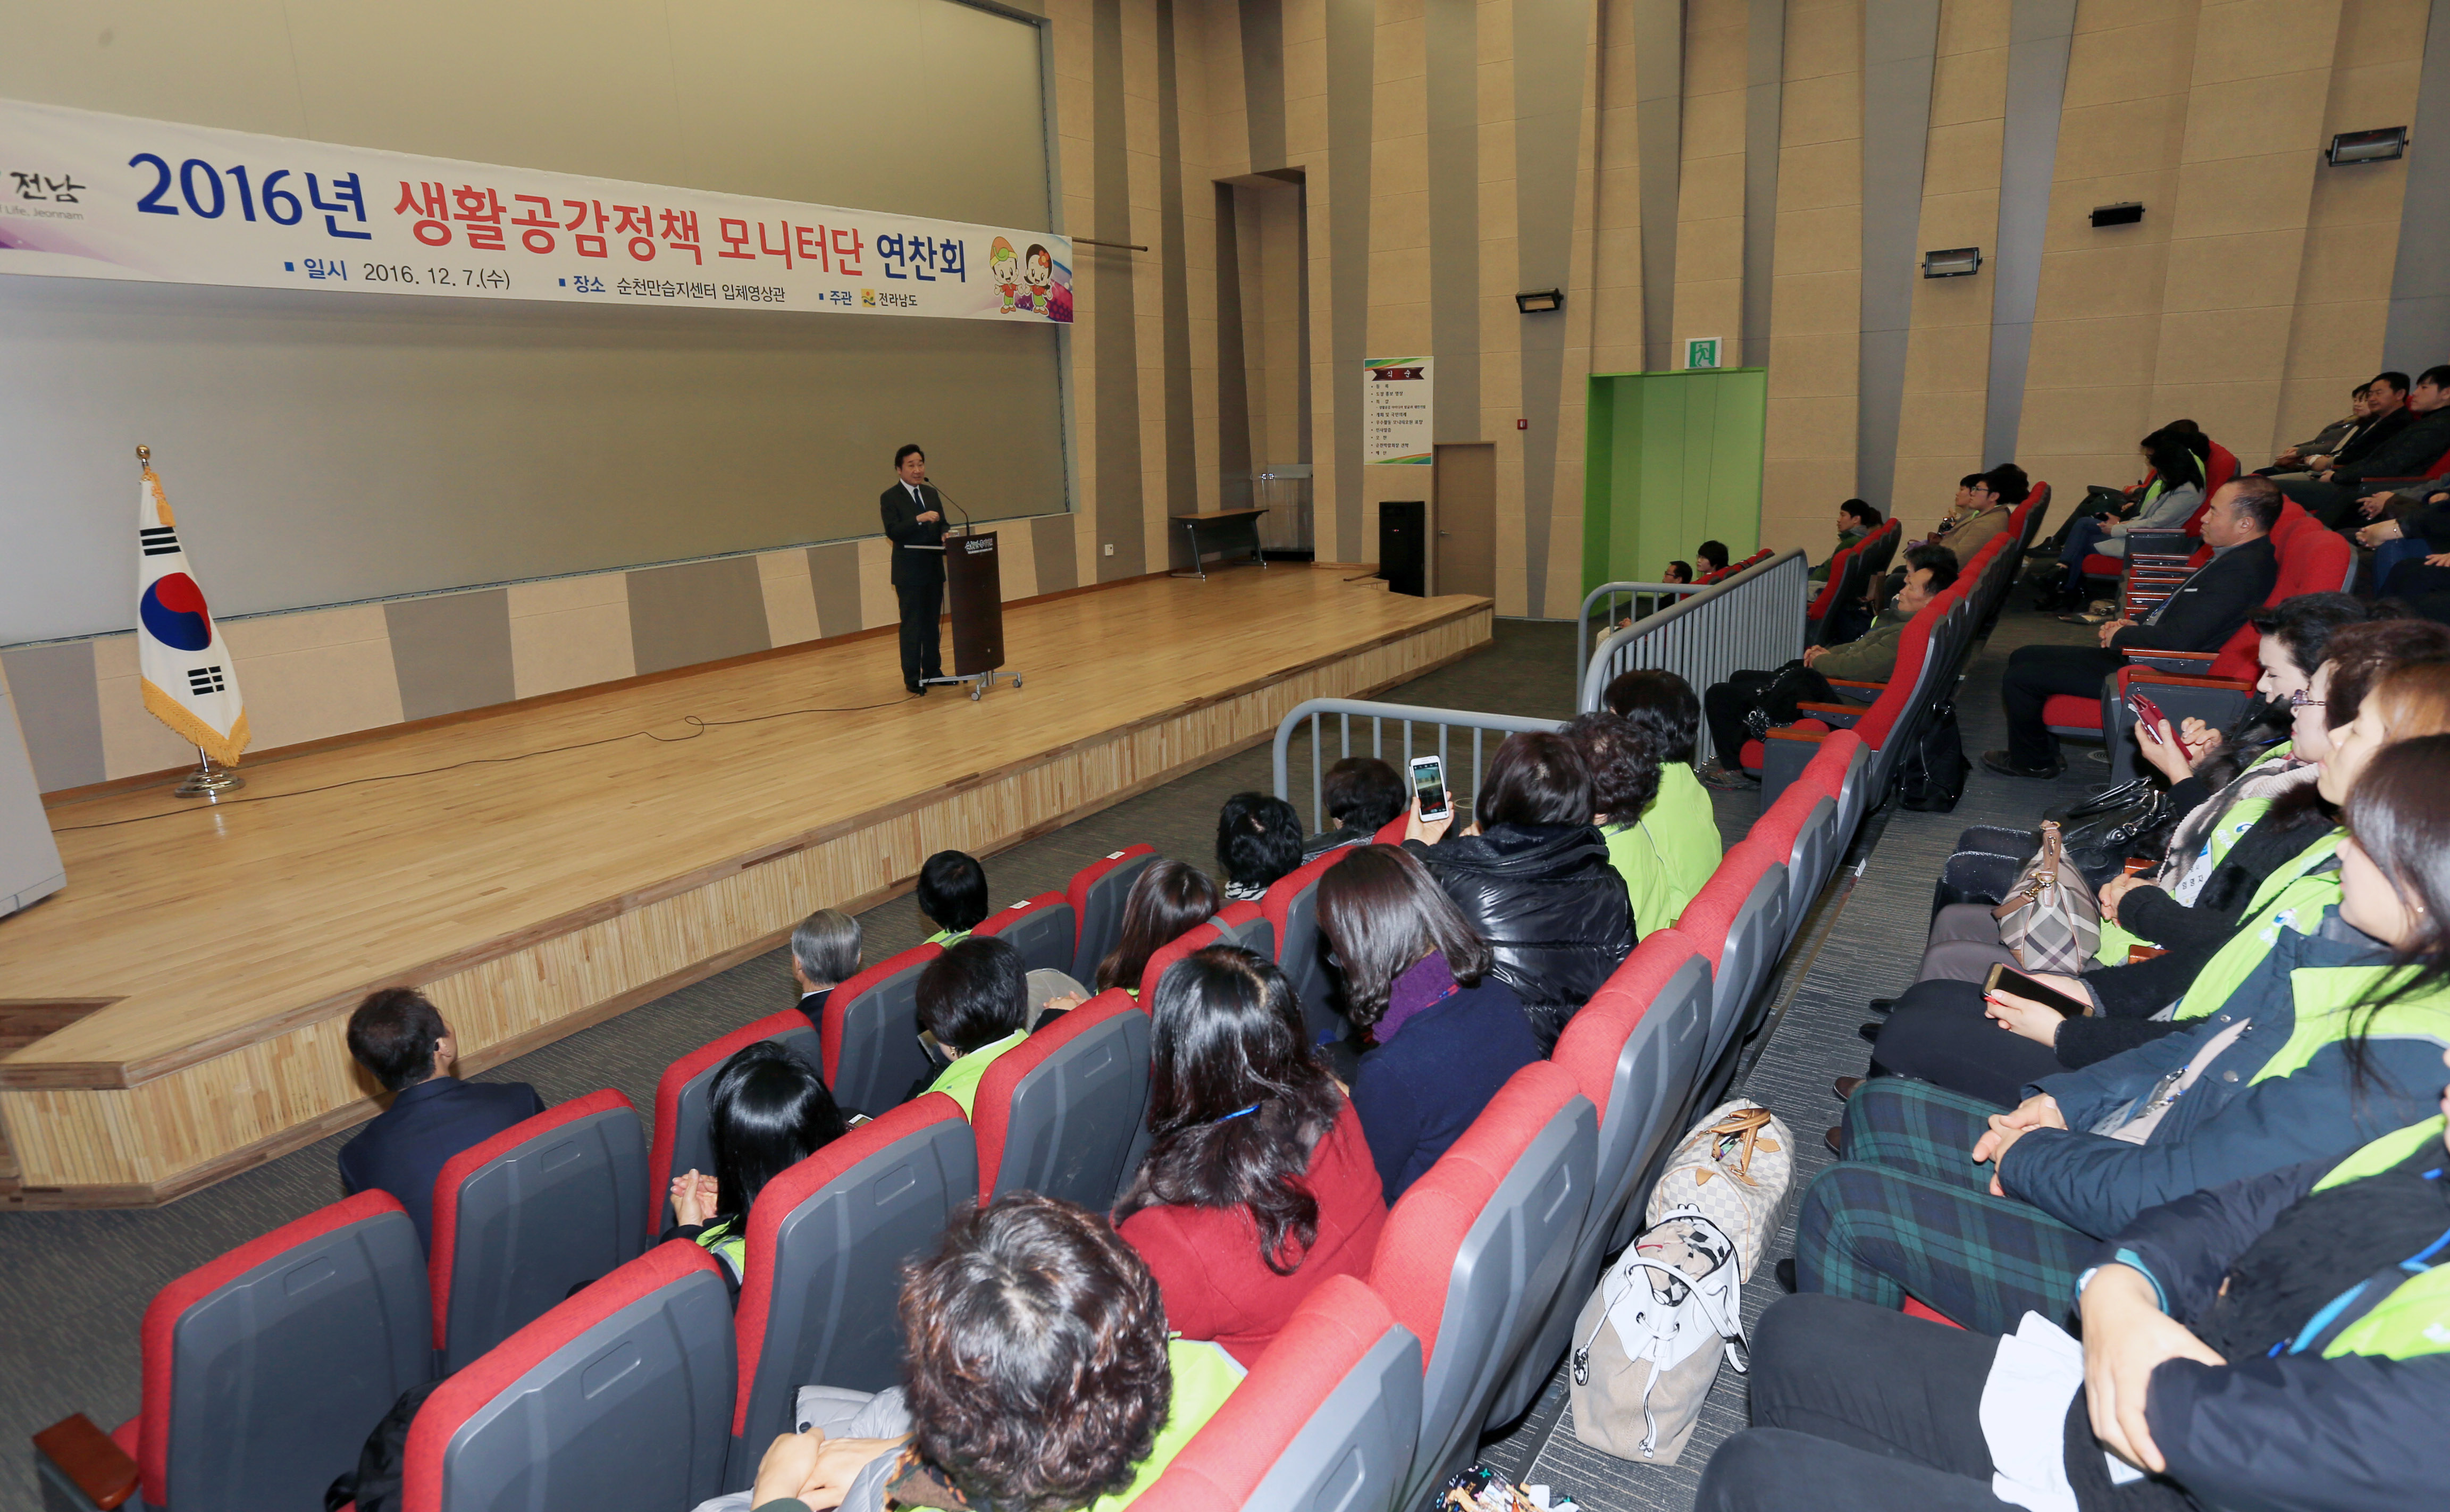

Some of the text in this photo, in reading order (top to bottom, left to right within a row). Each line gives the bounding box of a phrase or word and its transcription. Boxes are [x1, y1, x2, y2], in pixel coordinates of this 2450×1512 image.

[10, 172, 86, 203] 전남
[34, 208, 83, 220] Jeonnam
[128, 153, 965, 282] 2016년 생활공감정책 모니터단 연찬회
[304, 259, 347, 280] 일시
[364, 263, 419, 284] 2016.
[574, 275, 785, 302] 장소 순천만습지센터 입체영상관
[830, 291, 917, 307] 주관 전라남도
